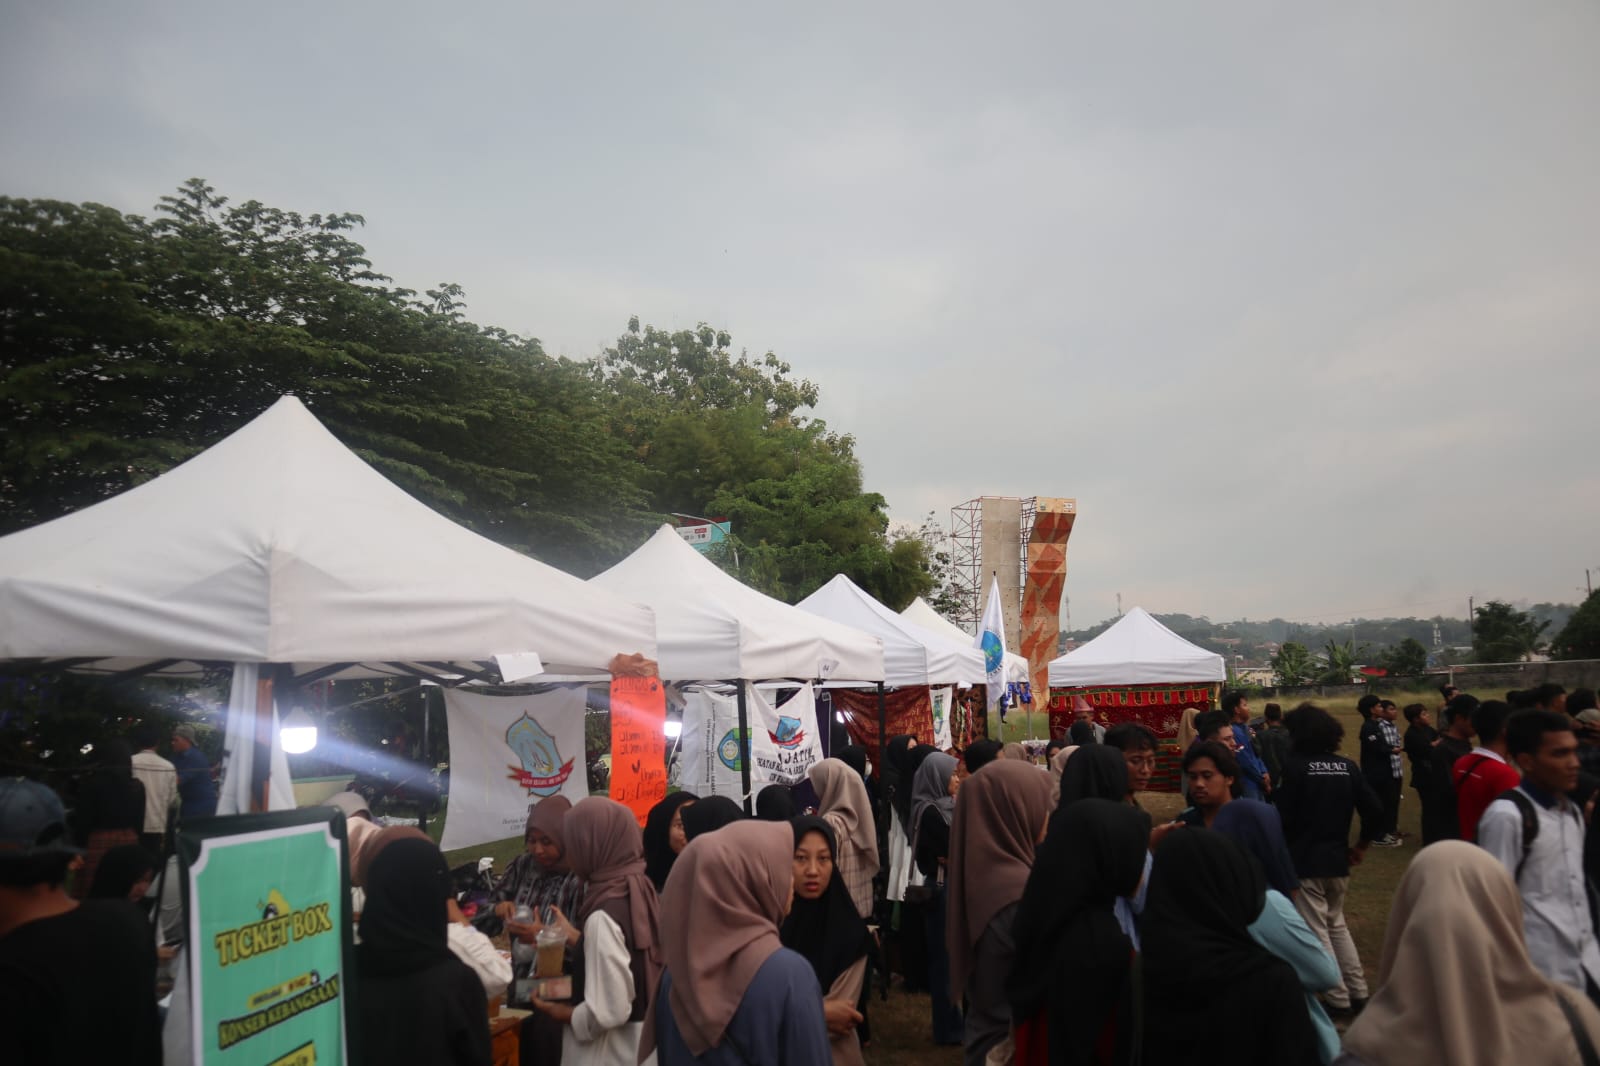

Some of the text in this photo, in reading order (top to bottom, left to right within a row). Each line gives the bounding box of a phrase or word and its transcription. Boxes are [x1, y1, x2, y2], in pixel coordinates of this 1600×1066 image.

[215, 902, 333, 967] TICKET BOX
[219, 1010, 267, 1050] KONSER
